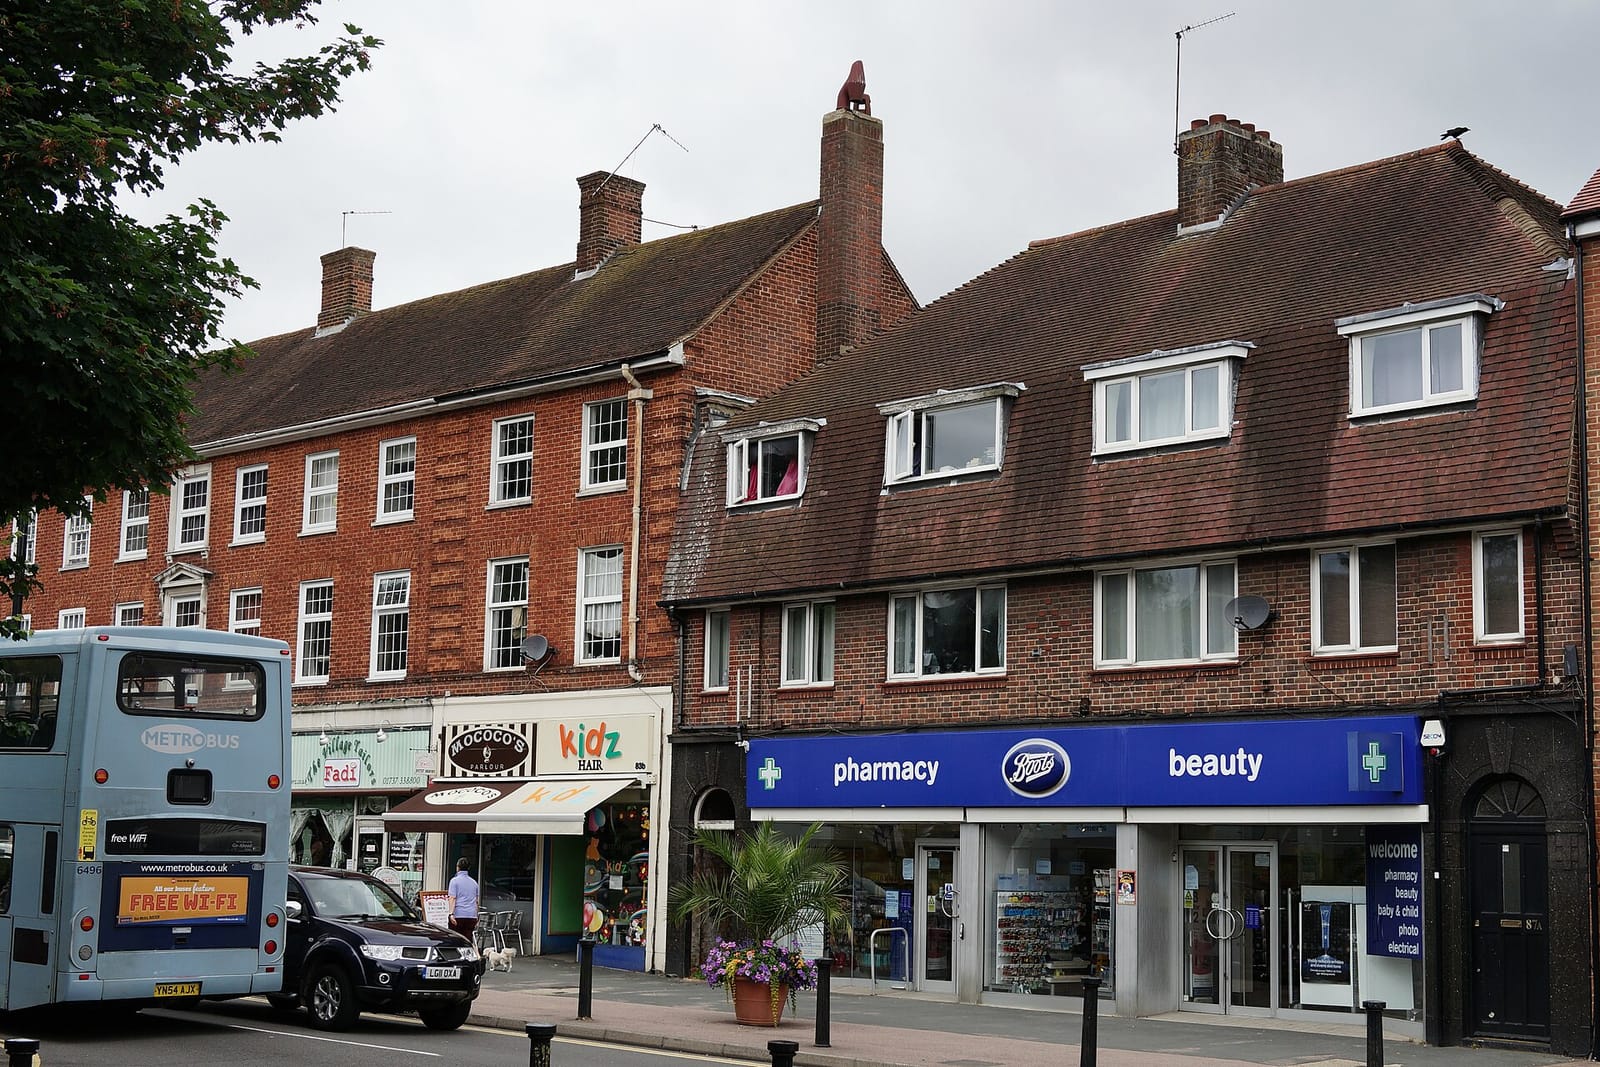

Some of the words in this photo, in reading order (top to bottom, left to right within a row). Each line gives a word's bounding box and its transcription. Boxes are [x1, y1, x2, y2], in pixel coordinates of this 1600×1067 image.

[144, 730, 240, 749] METROBUS
[450, 729, 525, 757] MOCOCO'S
[559, 721, 623, 760] kidz
[324, 762, 358, 783] Fadi
[577, 759, 603, 771] HAIR
[834, 756, 940, 787] pharmacy
[1009, 751, 1056, 783] Boots
[1169, 748, 1263, 782] beauty
[111, 833, 128, 843] free
[1369, 839, 1418, 859] welcome
[77, 865, 102, 875] 6496
[141, 862, 228, 872] www.metrobus.co.uk
[605, 860, 628, 874] kidz
[1384, 869, 1419, 883] pharmacy
[1395, 886, 1419, 902] beauty
[130, 893, 180, 912] FREE
[183, 893, 238, 911] WI-FI
[1377, 904, 1394, 919] baby
[1395, 905, 1401, 917] &
[1402, 905, 1419, 918] child
[1398, 923, 1419, 937] photo
[1388, 941, 1420, 955] electrical
[157, 985, 178, 995] YN54
[180, 984, 196, 994] AJX
